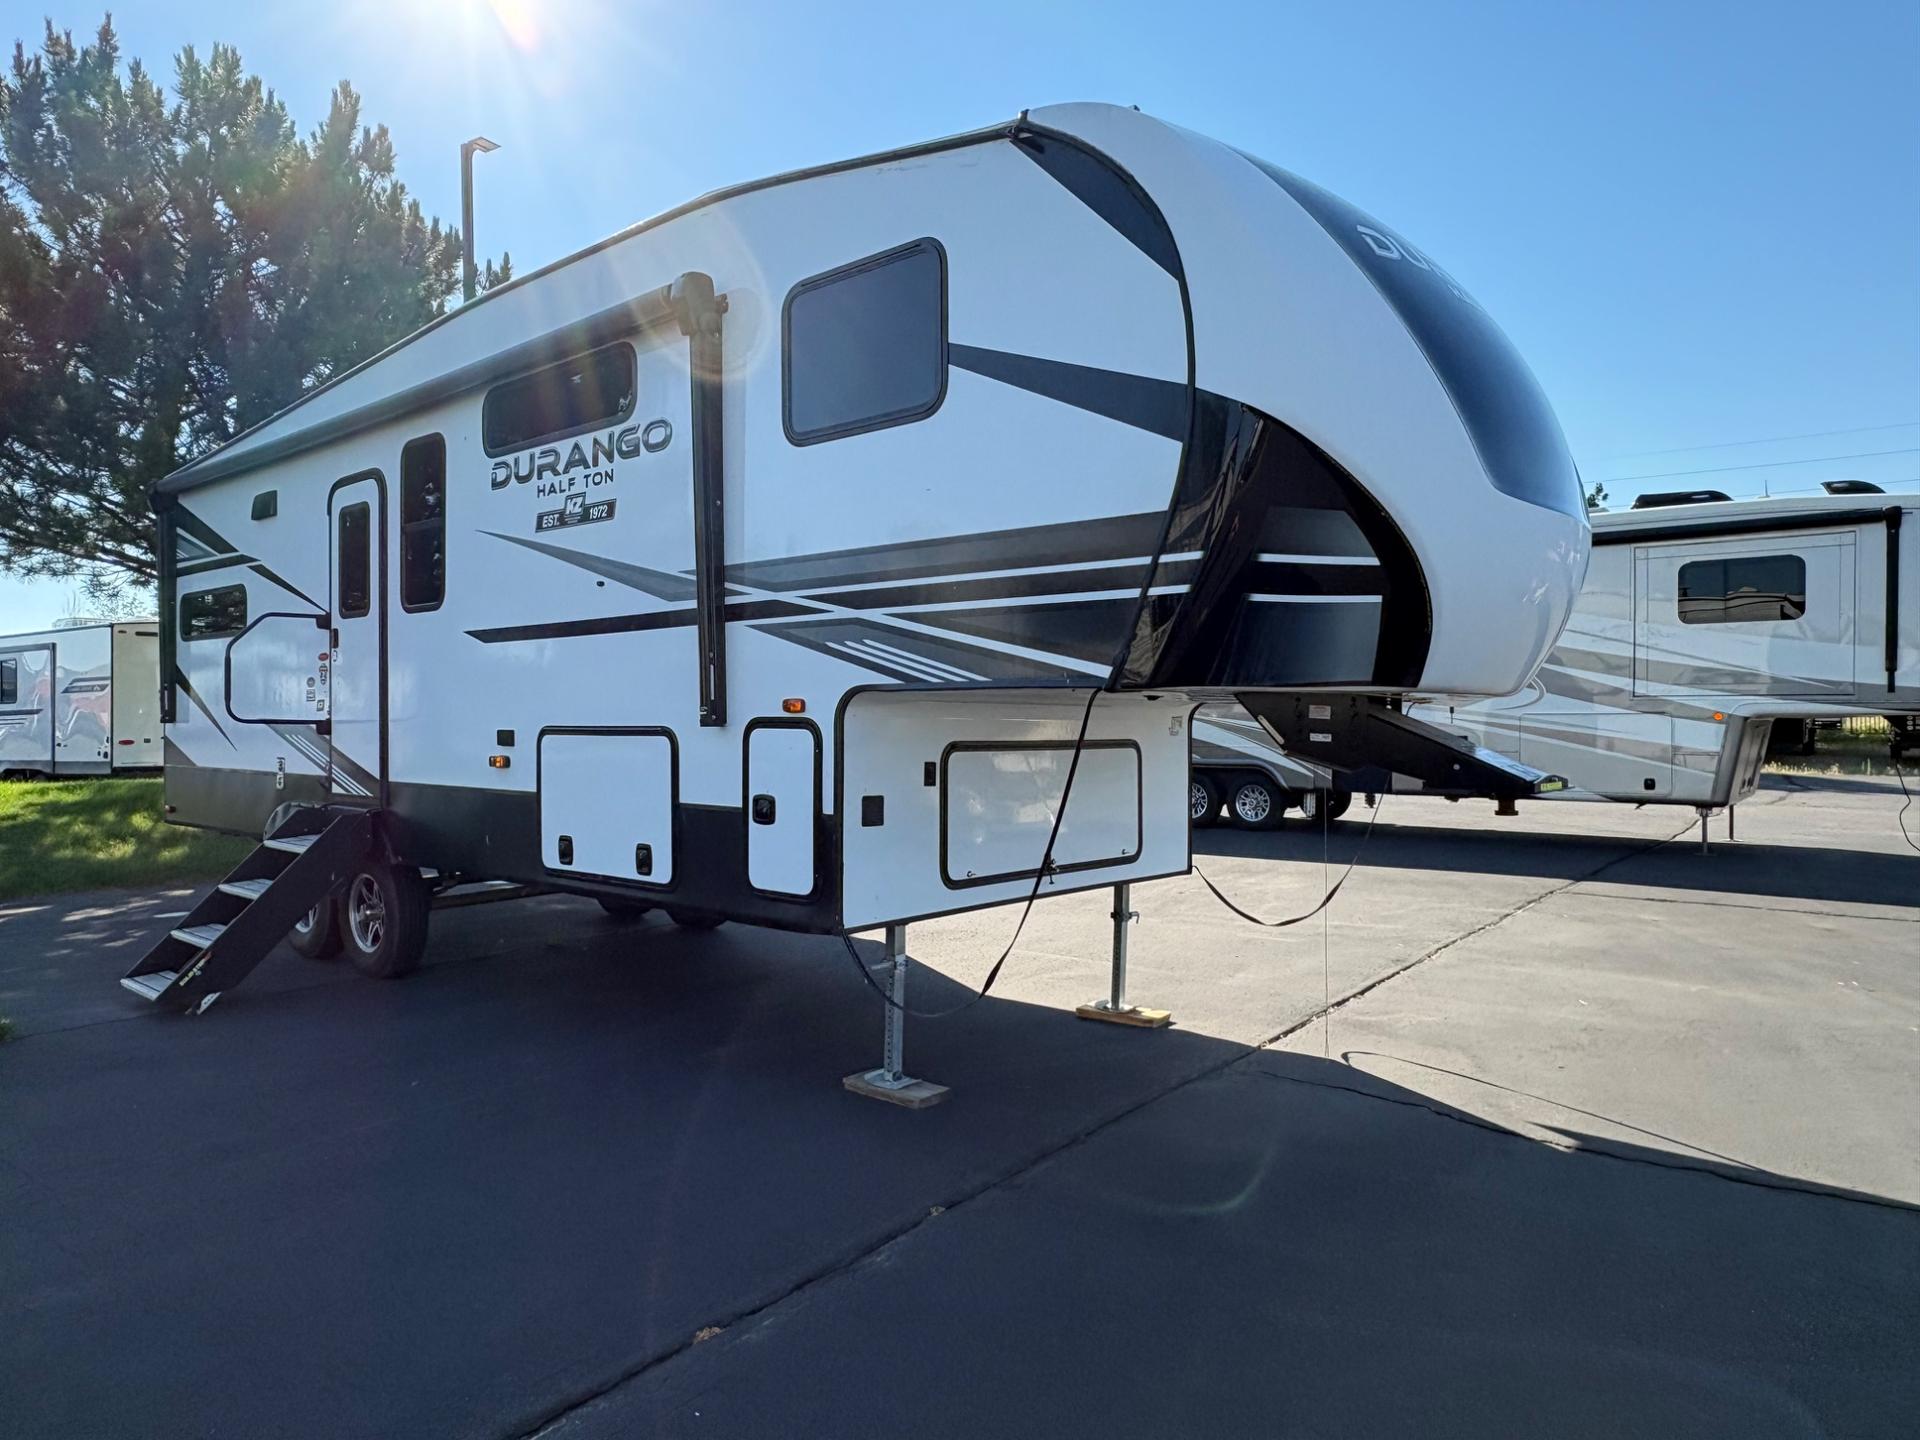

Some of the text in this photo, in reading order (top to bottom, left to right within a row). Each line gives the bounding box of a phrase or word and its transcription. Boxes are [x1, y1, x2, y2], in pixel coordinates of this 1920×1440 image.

[491, 417, 673, 491] DURANGO
[536, 468, 614, 498] HALF TON
[542, 504, 608, 528] EST. 1972
[565, 496, 584, 514] KZ
